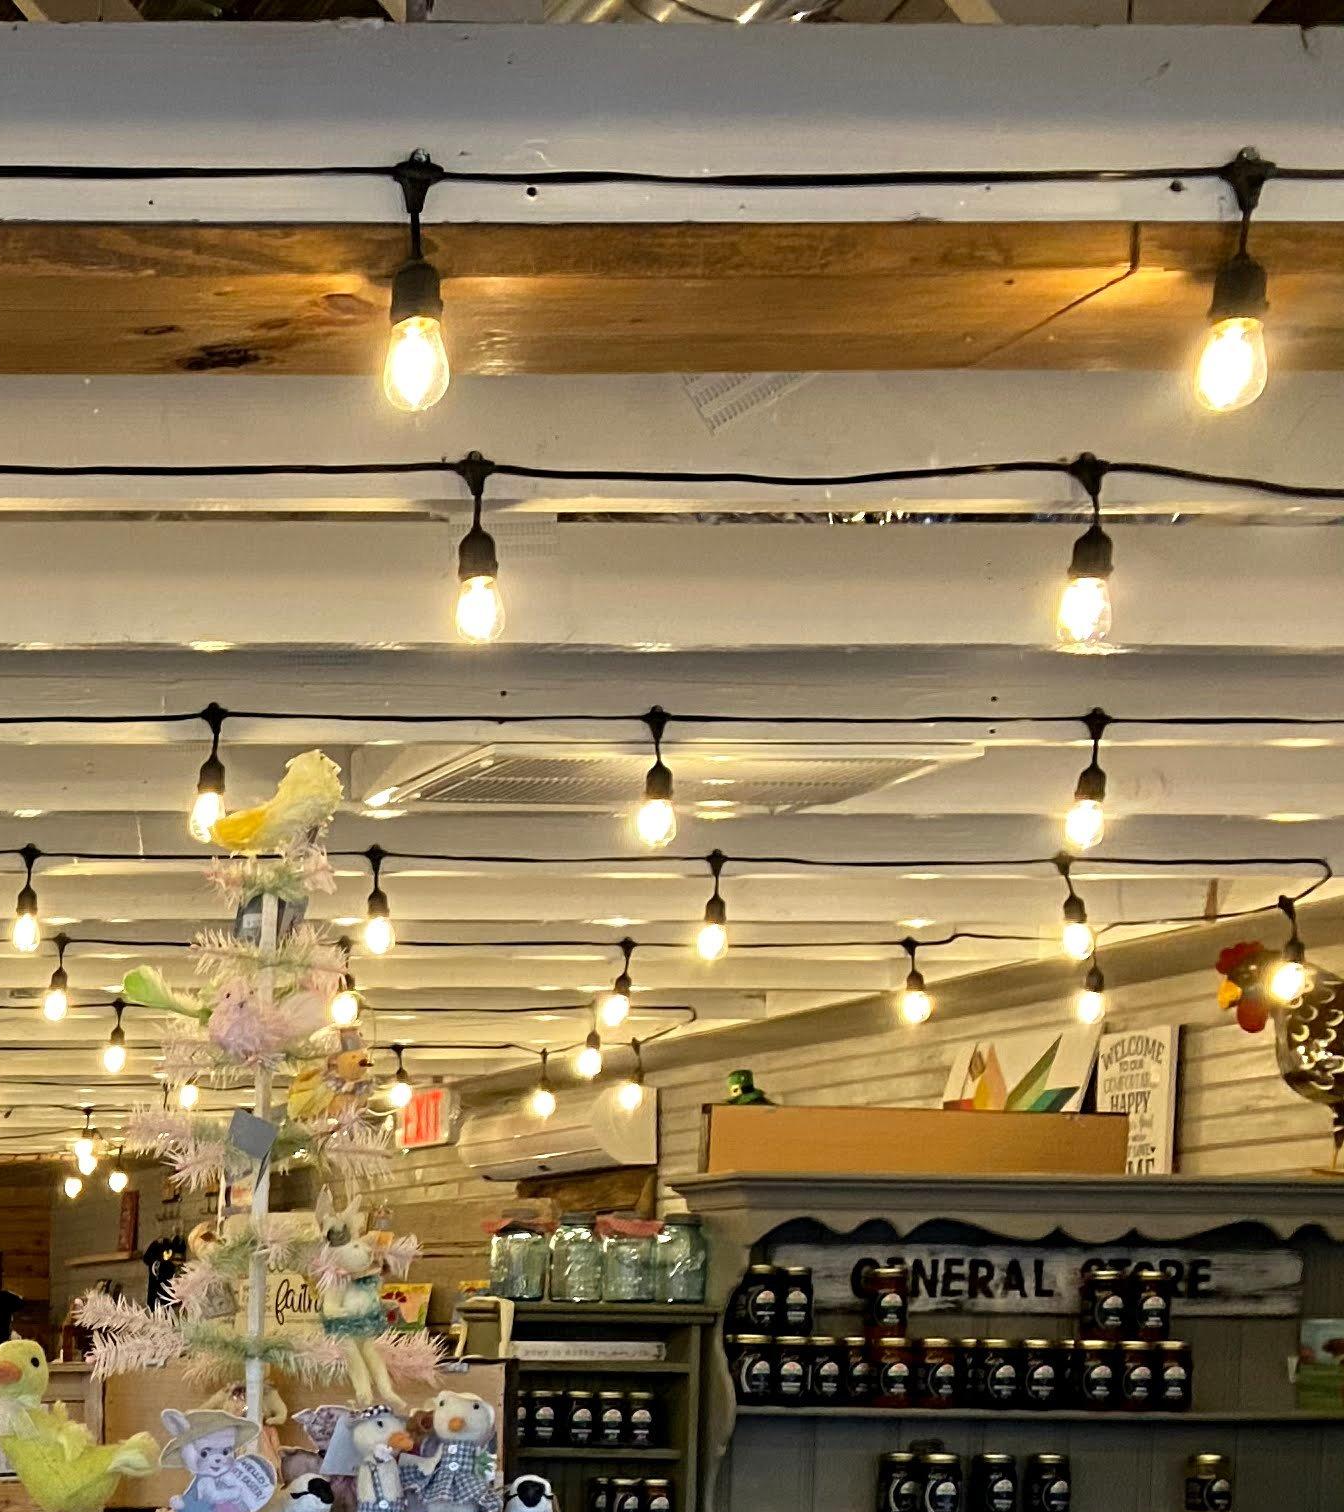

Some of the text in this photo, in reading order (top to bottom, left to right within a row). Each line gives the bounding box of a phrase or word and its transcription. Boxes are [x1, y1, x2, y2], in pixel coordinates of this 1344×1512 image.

[1101, 1034, 1165, 1071] WELCOME
[403, 1089, 441, 1145] EXIT
[1110, 1089, 1152, 1114] HAPPY
